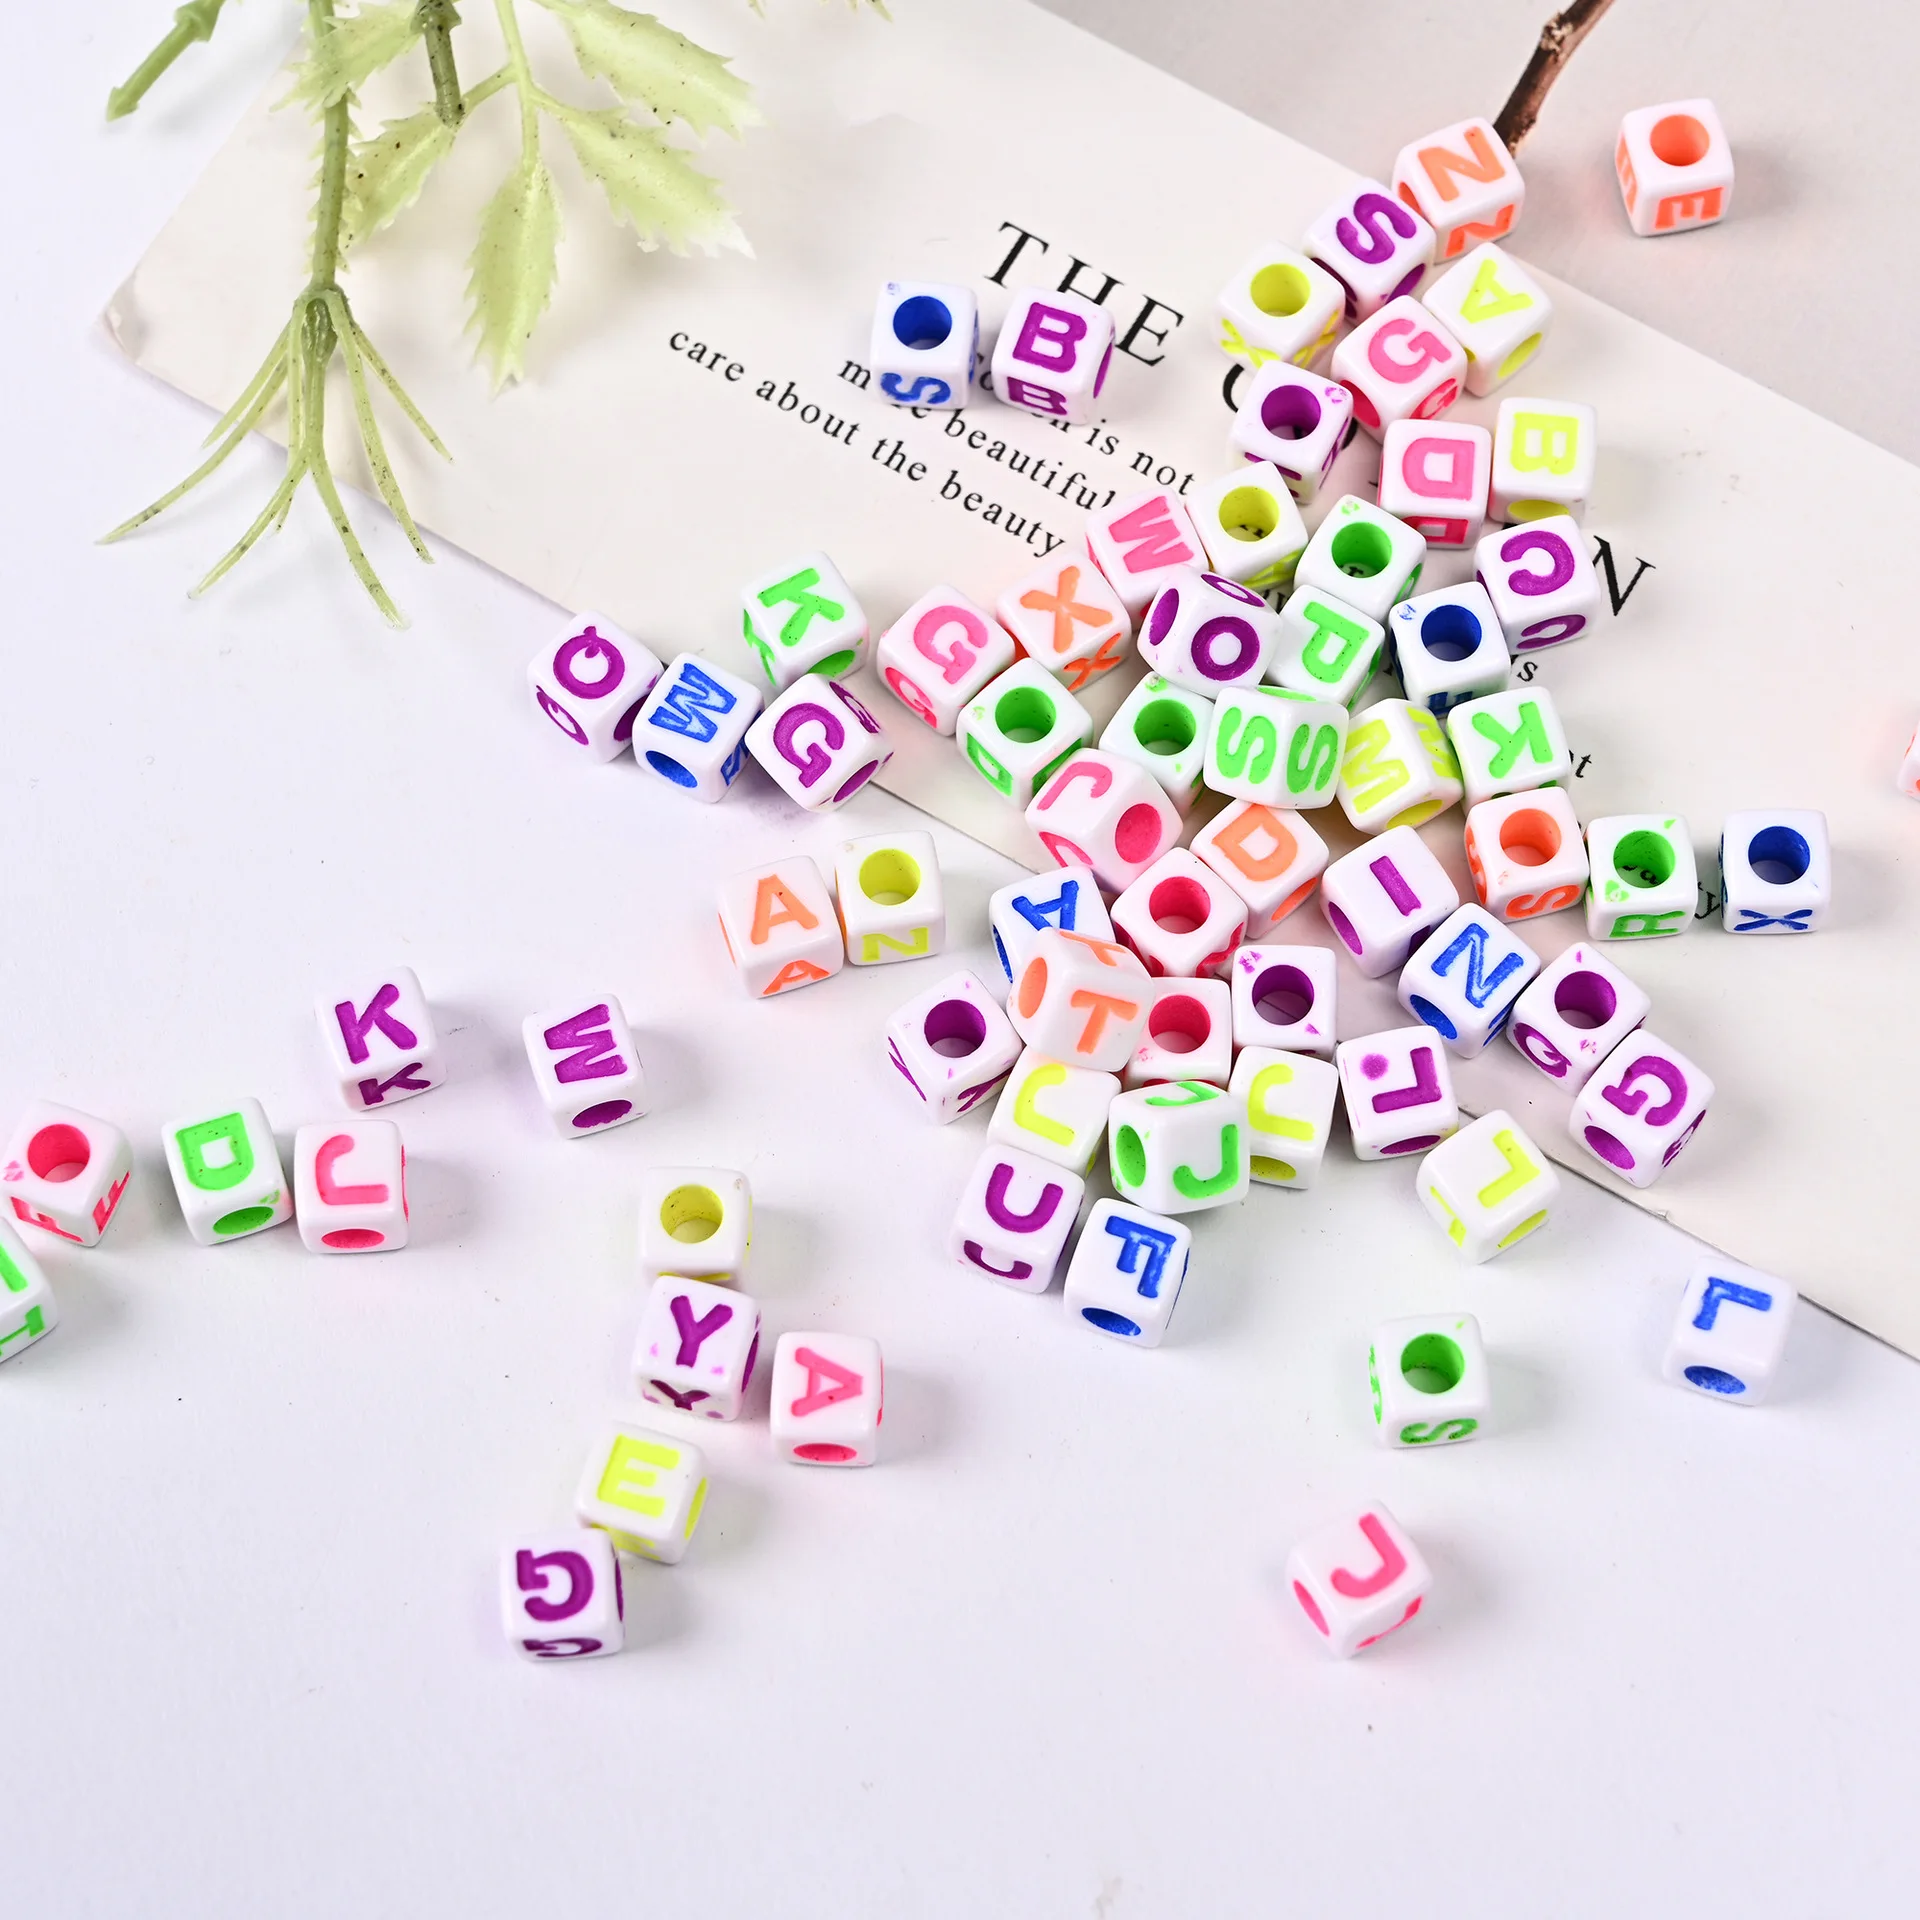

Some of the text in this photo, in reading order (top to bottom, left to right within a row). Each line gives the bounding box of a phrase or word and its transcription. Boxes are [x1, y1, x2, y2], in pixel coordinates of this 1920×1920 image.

[1336, 193, 1418, 265] S
[1654, 187, 1724, 231] E
[1460, 260, 1533, 324] A
[1013, 302, 1088, 374] B
[1368, 318, 1452, 385] G
[881, 373, 952, 405] S
[1007, 377, 1068, 416] B
[669, 332, 1066, 559] care about the beauty
[1085, 416, 1120, 456] is
[1130, 450, 1196, 498] not
[1402, 437, 1476, 501] D
[1510, 413, 1579, 476] B
[1500, 530, 1576, 597] C
[758, 568, 845, 648] K
[1020, 566, 1112, 654] X
[1302, 602, 1370, 684] P
[553, 626, 626, 700] Q
[913, 606, 989, 685] G
[1191, 616, 1261, 682] O
[773, 703, 846, 789] G
[1216, 707, 1278, 785] S
[1287, 724, 1340, 795] S
[1472, 702, 1554, 779] K
[1212, 802, 1298, 882] D
[751, 875, 819, 945] A
[1504, 884, 1581, 920] S
[1610, 911, 1686, 939] R
[1735, 909, 1813, 932] X
[335, 984, 419, 1065] K
[1071, 990, 1139, 1054] T
[358, 1064, 432, 1106] K
[1247, 1064, 1315, 1142] J
[1602, 1056, 1689, 1127] G
[175, 1113, 255, 1192] D
[315, 1134, 389, 1207] J
[1173, 1124, 1240, 1200] J
[1478, 1130, 1541, 1209] L
[985, 1163, 1064, 1234] U
[1105, 1216, 1177, 1300] F
[670, 1296, 734, 1368] Y
[791, 1347, 863, 1418] A
[597, 1435, 681, 1518] E
[1330, 1514, 1407, 1600] J
